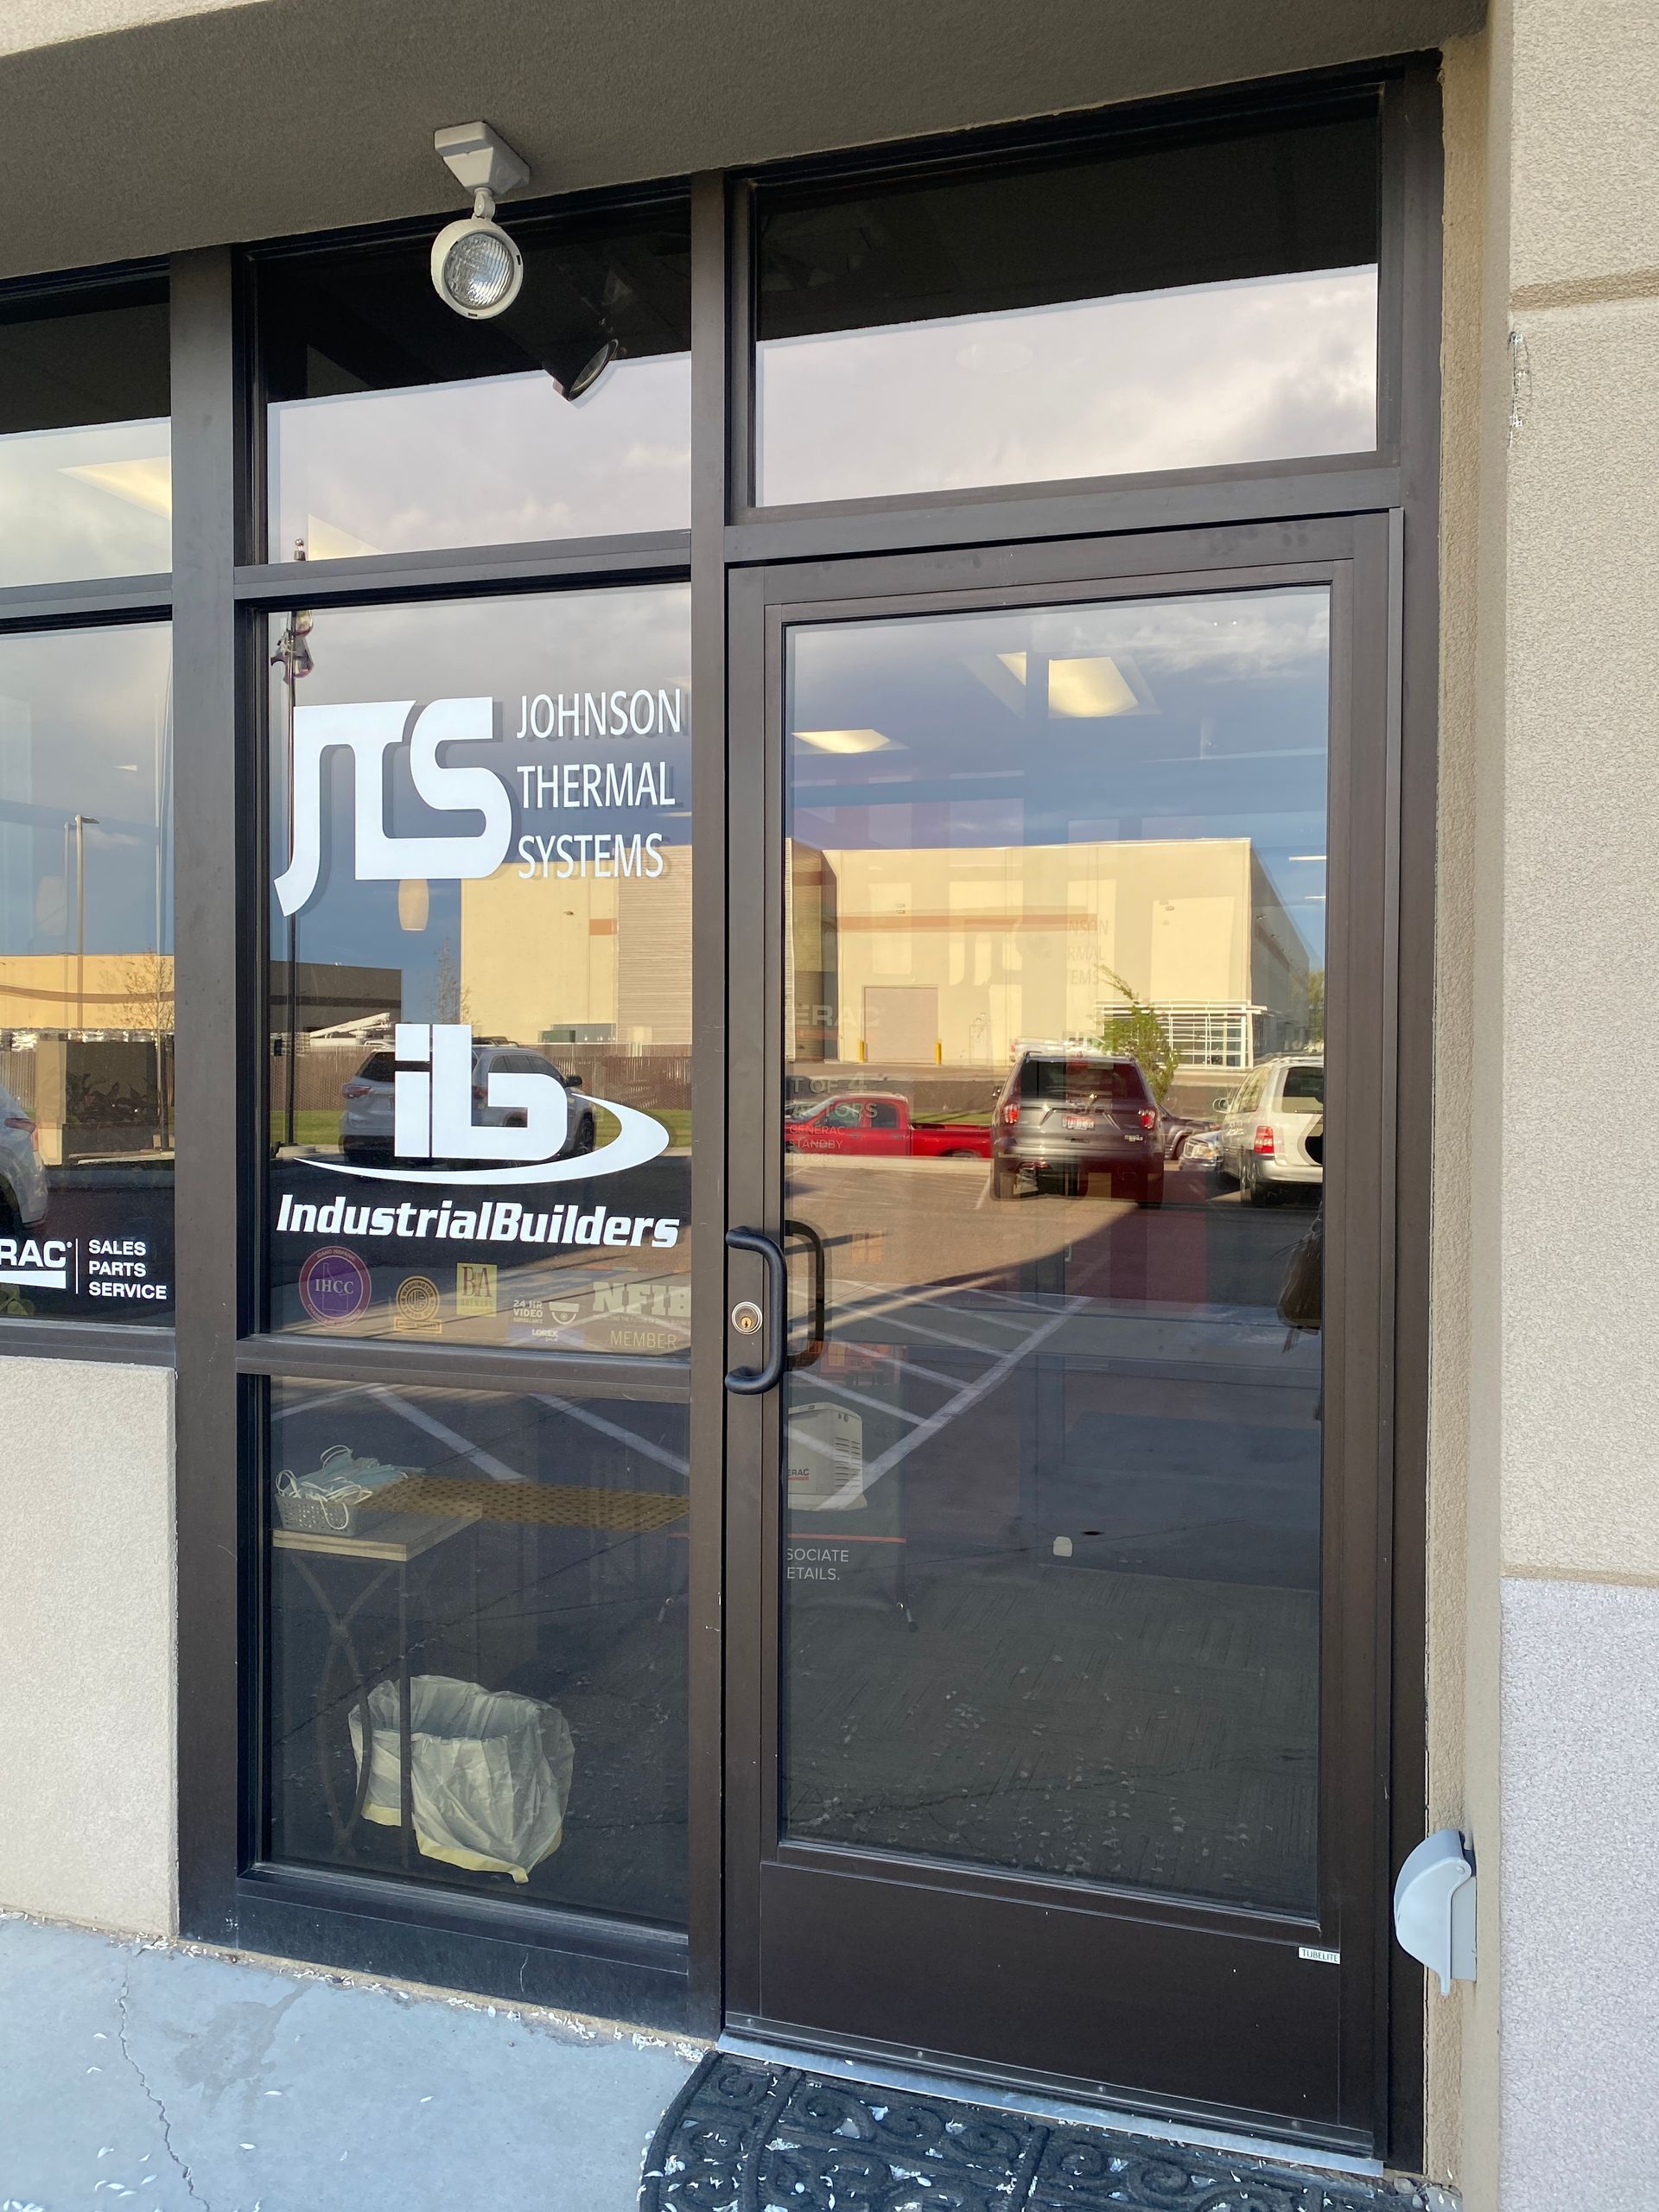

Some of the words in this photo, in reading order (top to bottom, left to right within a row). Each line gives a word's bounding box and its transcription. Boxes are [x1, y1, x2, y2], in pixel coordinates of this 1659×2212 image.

[517, 689, 681, 738] JOHNSON
[517, 761, 676, 809] THERMAL
[518, 833, 664, 879] SYSTEMS
[790, 1125, 846, 1135] GENERAC
[789, 1140, 843, 1149] STANDBY
[276, 1194, 680, 1248] IndustrialBuilders
[88, 1239, 147, 1256] SALES
[88, 1260, 147, 1278] PARTS
[88, 1281, 168, 1300] SERVICE
[315, 1279, 354, 1294] IHCC
[402, 1281, 434, 1298] WASHINGTON
[513, 1300, 526, 1308] 24
[529, 1300, 543, 1309] HR
[593, 1281, 691, 1318] NFIB
[513, 1308, 543, 1319] VIDEO
[610, 1331, 677, 1350] MEMBER
[786, 1548, 849, 1563] SOCIATE
[787, 1567, 840, 1581] ETAILS.
[1301, 1948, 1338, 1962] TUBELITE
